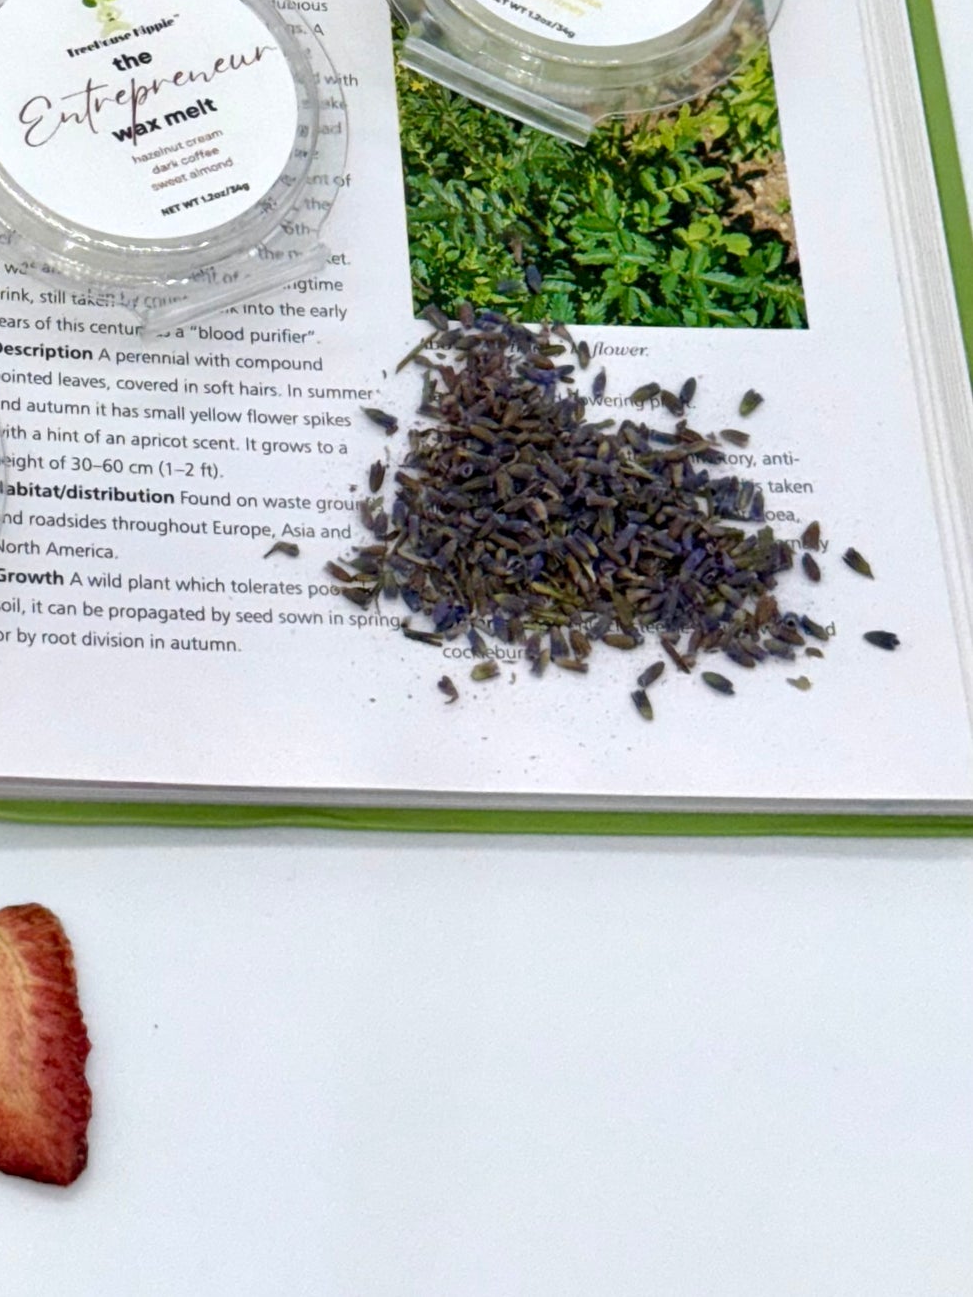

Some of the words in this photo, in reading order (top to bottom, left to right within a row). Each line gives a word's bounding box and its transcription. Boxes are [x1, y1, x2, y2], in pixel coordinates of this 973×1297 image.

[510, 1, 527, 14] WT
[112, 50, 153, 72] the
[19, 45, 277, 147] Entrepreneur
[112, 116, 161, 143] wax
[164, 96, 218, 127] melt
[132, 142, 184, 165] hazelnut
[186, 127, 223, 148] cream
[152, 159, 178, 176] dark
[180, 146, 220, 166] coffee
[151, 172, 187, 193] sweet
[189, 157, 234, 179] almond
[161, 204, 181, 218] NET
[183, 197, 200, 211] WT
[201, 180, 250, 203] 1.2oz/34g
[99, 349, 110, 362] A
[116, 349, 190, 367] perennial
[195, 353, 231, 369] with
[235, 356, 323, 374] compound
[70, 571, 82, 586] A
[87, 572, 123, 589] wild
[128, 574, 171, 593] plant
[175, 575, 225, 594] which
[231, 578, 302, 597] tolerates
[17, 627, 36, 647] by
[41, 630, 76, 647] root
[81, 630, 145, 649] division
[150, 635, 165, 649] in
[171, 635, 242, 653] autumn.
